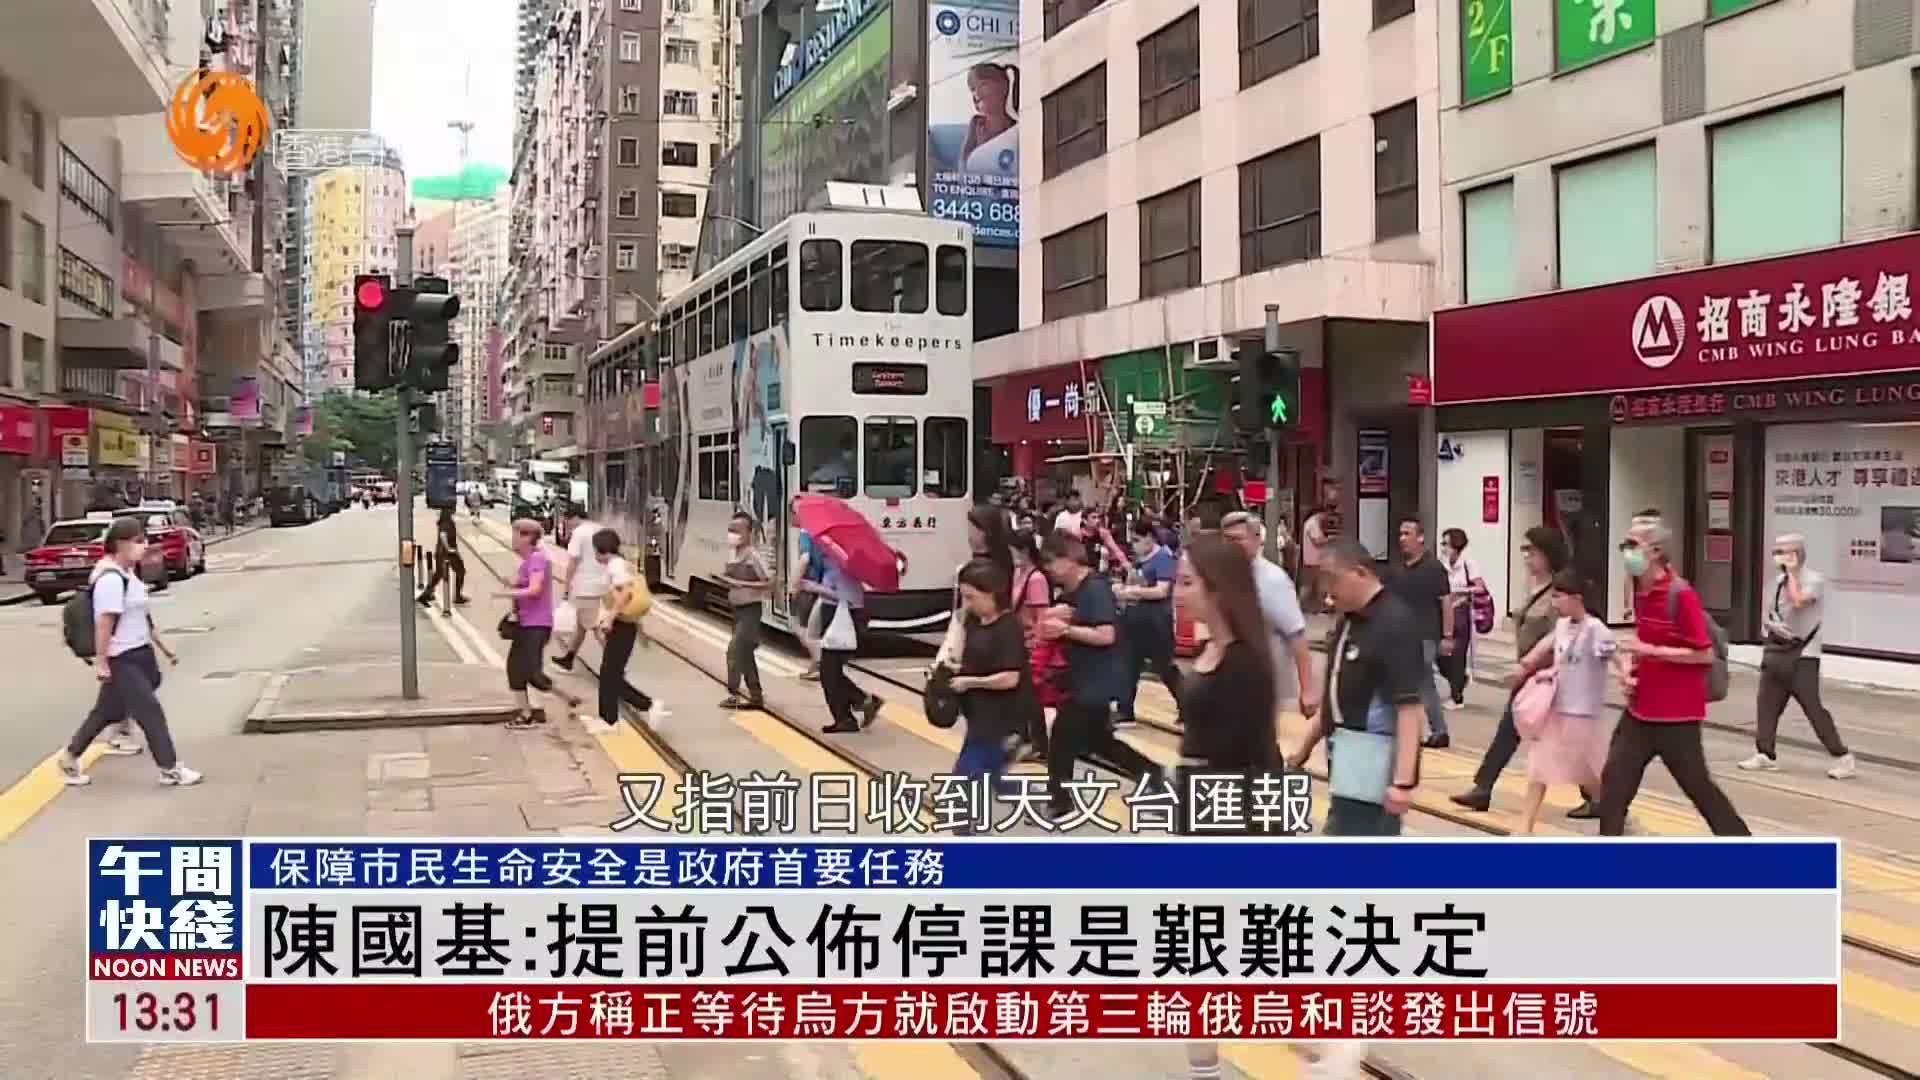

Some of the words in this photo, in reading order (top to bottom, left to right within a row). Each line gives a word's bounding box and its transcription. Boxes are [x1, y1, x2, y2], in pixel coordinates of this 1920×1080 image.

[967, 15, 999, 32] CHI
[1468, 0, 1509, 74] 2/F
[933, 184, 947, 193] TO
[933, 198, 983, 220] 3443
[812, 332, 961, 352] Timekeepers
[1698, 346, 1739, 363] CMB
[1749, 339, 1804, 358] WING
[1815, 332, 1879, 352] LUNG
[1733, 393, 1777, 410] CMB
[1784, 389, 1845, 407] WING
